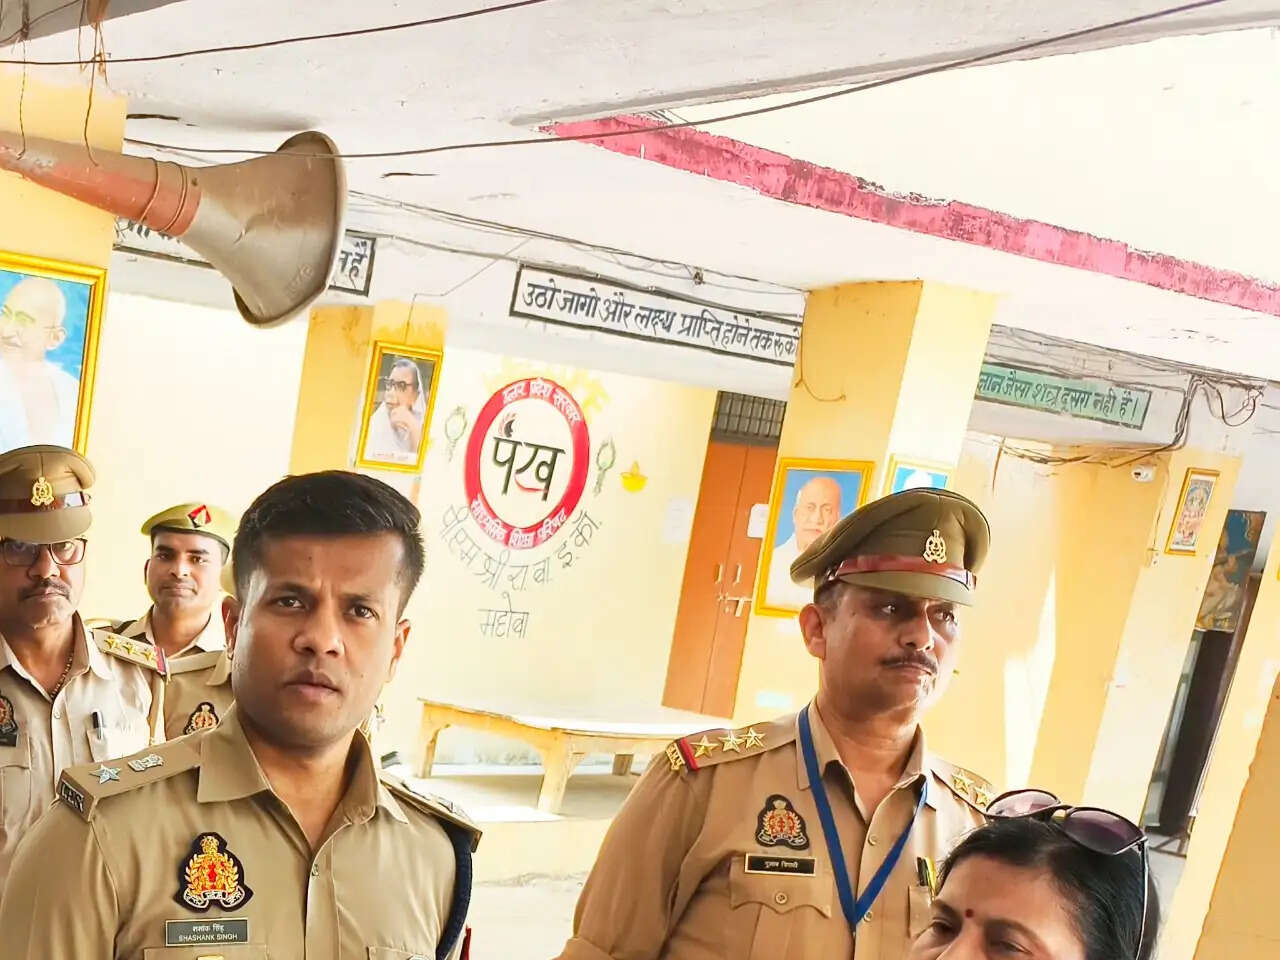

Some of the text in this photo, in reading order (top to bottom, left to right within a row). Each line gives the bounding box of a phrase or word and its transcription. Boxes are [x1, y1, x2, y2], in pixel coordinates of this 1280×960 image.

[523, 278, 561, 310] उठो
[556, 287, 601, 318] जागो
[599, 291, 636, 329] और
[677, 308, 724, 345] प्राप्ति
[721, 315, 752, 349] होने
[750, 328, 774, 351] तक
[179, 933, 238, 942] SHASHANK SINGH
